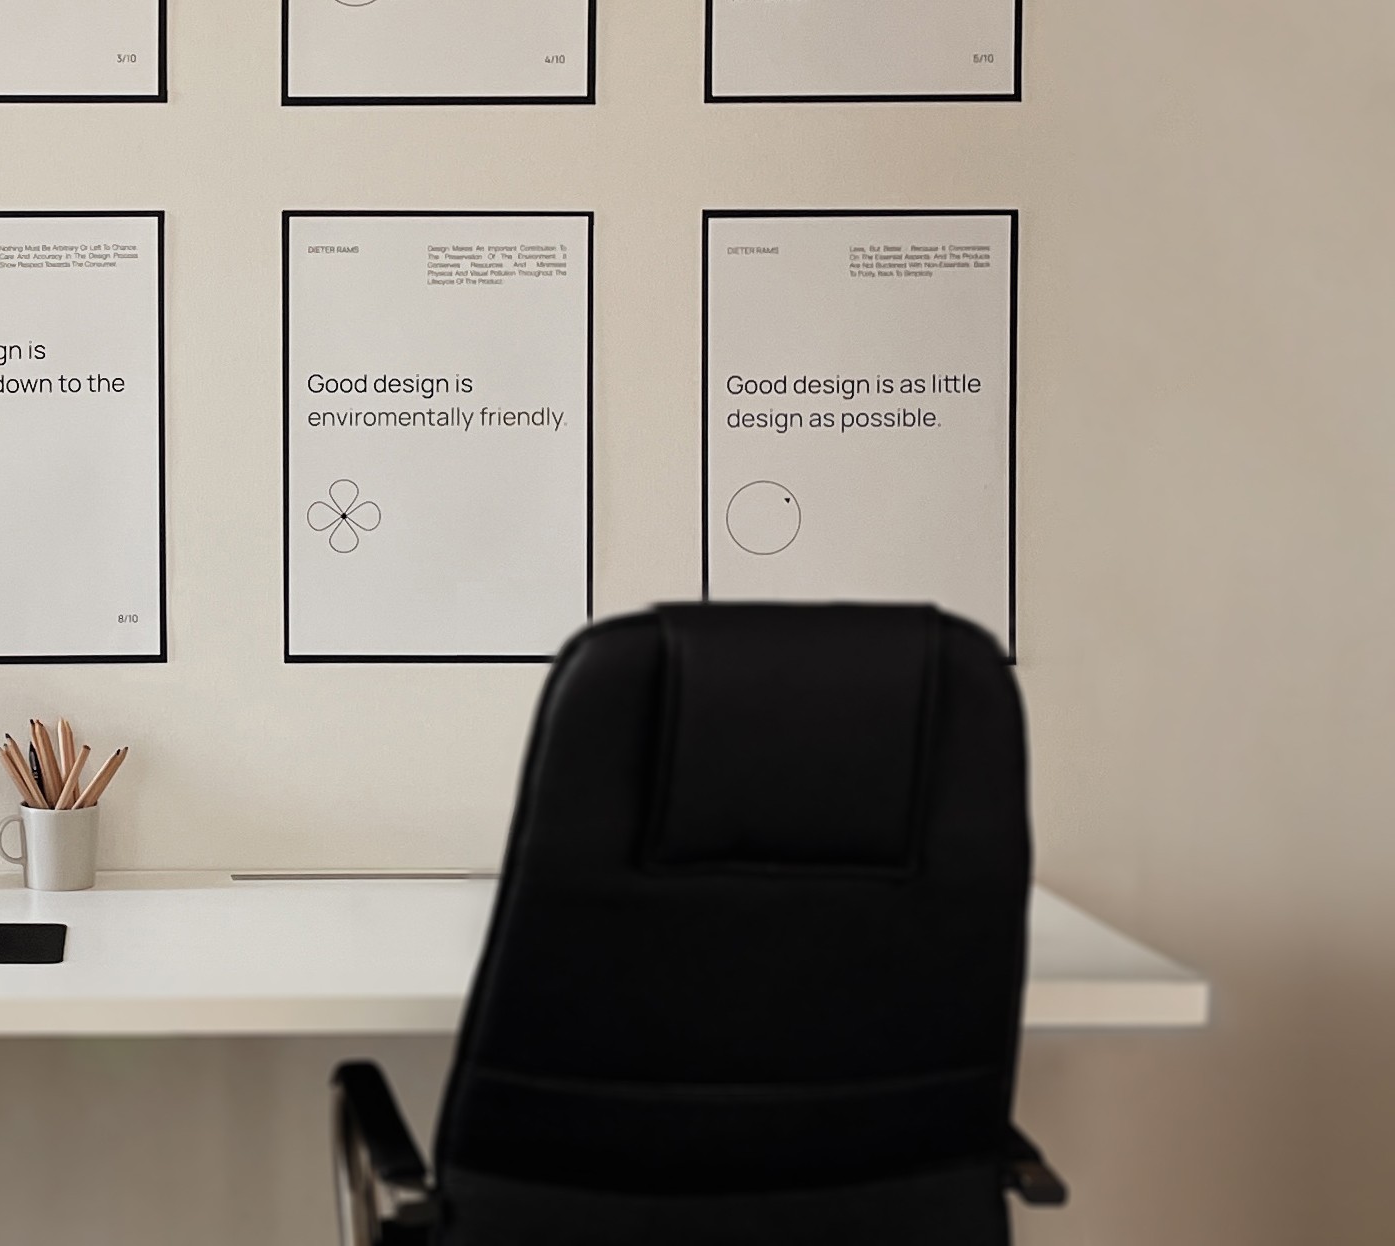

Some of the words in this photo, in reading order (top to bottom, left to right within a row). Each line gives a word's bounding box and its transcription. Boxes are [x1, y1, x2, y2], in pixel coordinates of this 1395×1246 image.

[116, 53, 137, 64] 3/10
[544, 54, 566, 64] 4/10
[972, 53, 995, 64] 5/10
[307, 245, 336, 255] DIETER
[336, 245, 360, 254] RAMS
[726, 246, 756, 255] DIETER
[755, 246, 779, 255] RAMS
[28, 340, 46, 360] is
[57, 374, 82, 394] to
[85, 373, 126, 393] the
[307, 373, 368, 394] Good
[373, 373, 450, 400] design
[455, 373, 473, 394] is
[726, 374, 787, 396] Good
[793, 374, 870, 401] design
[876, 374, 895, 394] is
[899, 378, 926, 394] as
[932, 373, 982, 394] little
[307, 406, 475, 433] enviromentally
[479, 406, 568, 432] friendly.
[726, 408, 803, 434] design
[808, 412, 835, 428] as
[841, 407, 942, 434] possible.
[117, 613, 139, 624] 8/10
